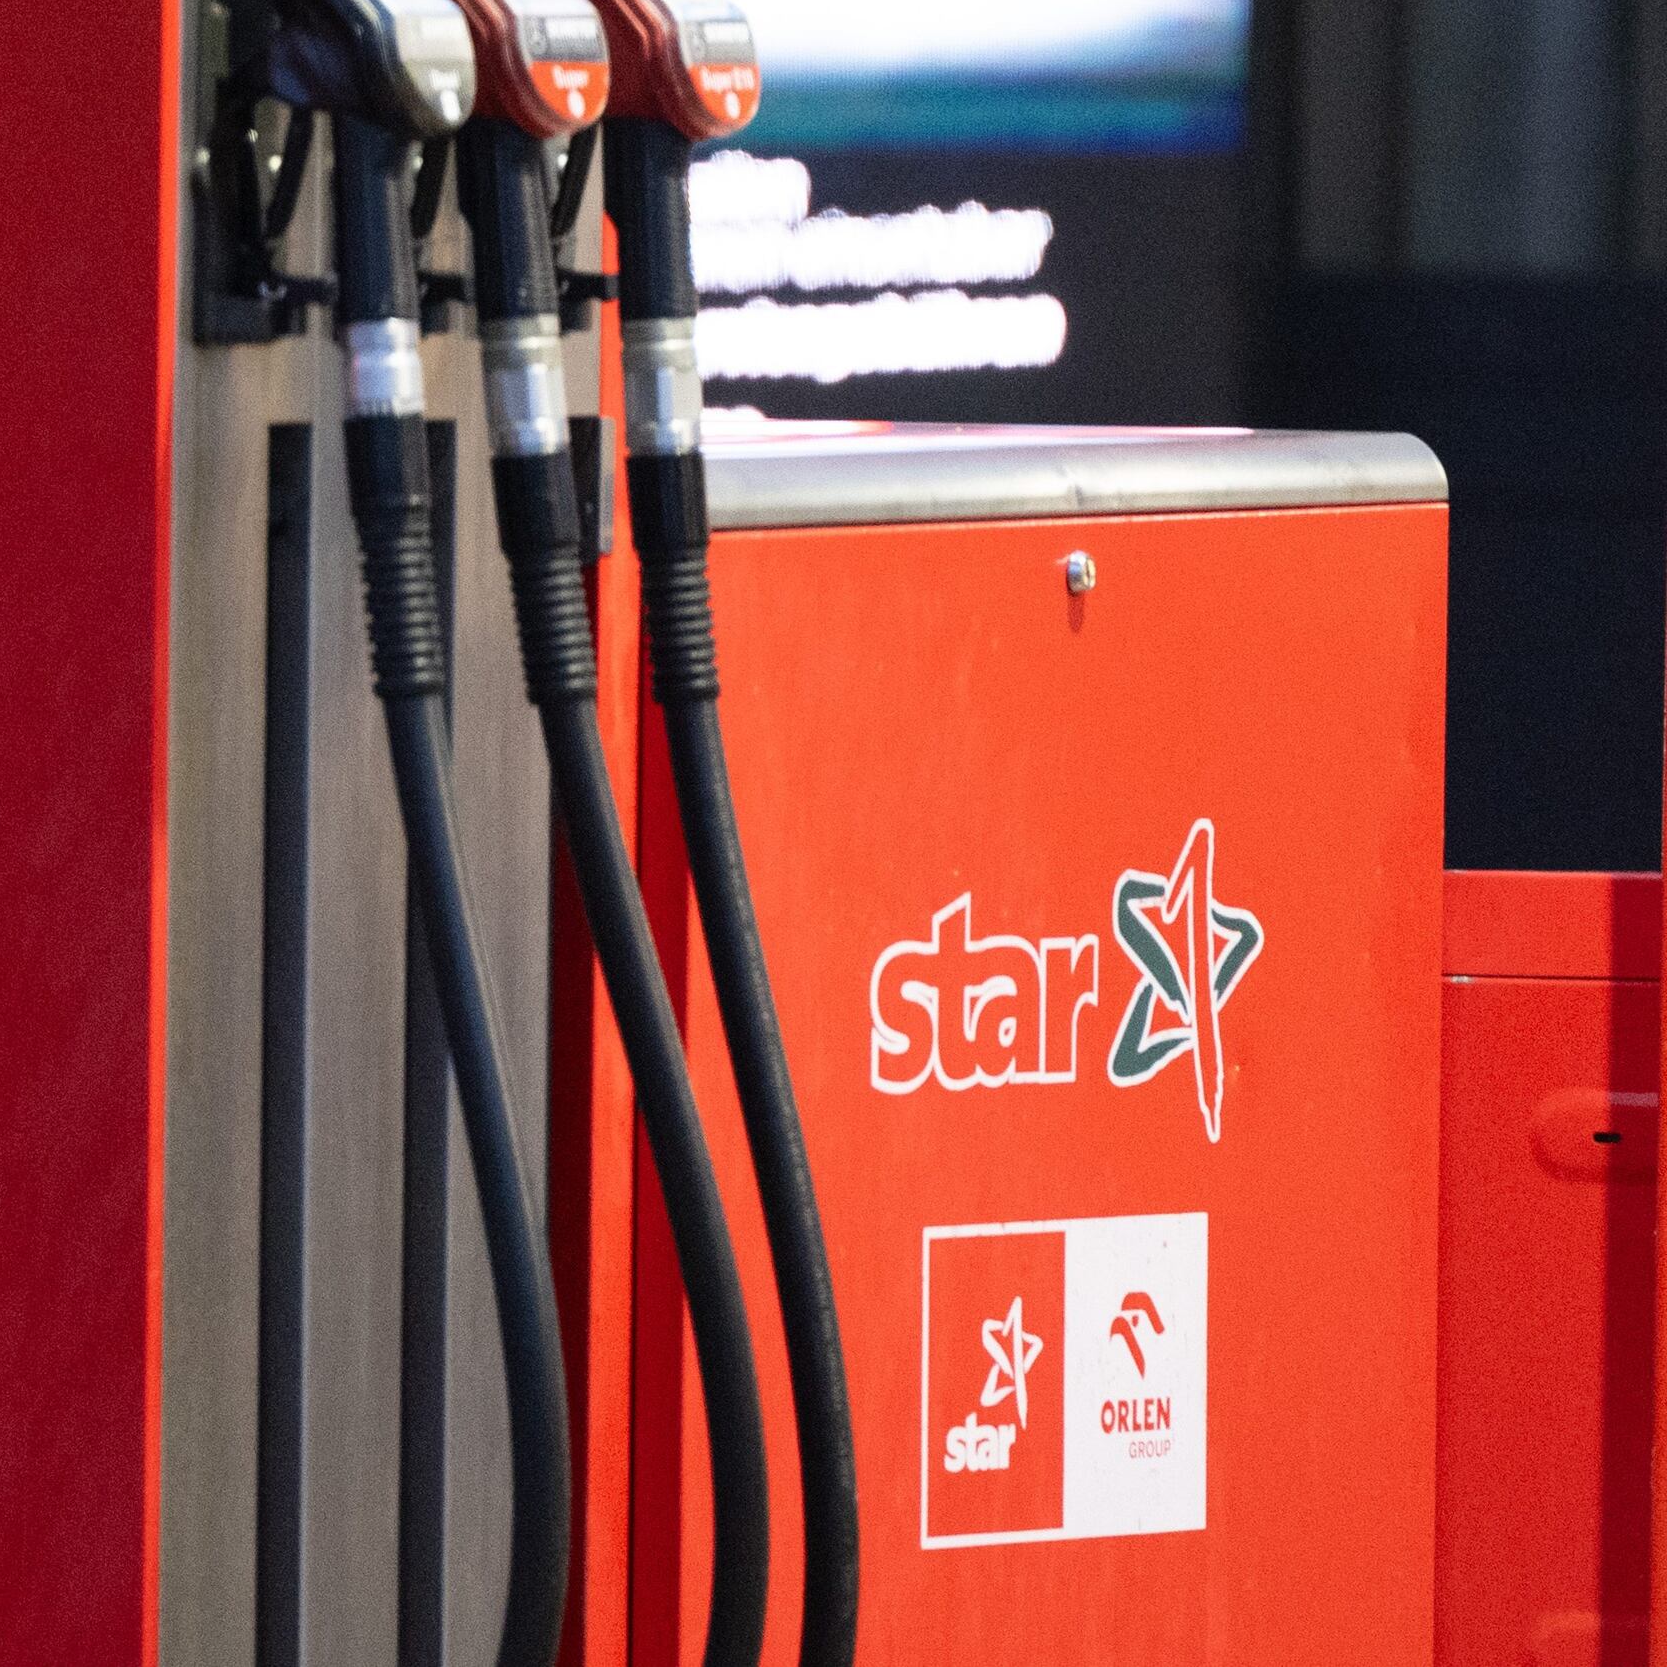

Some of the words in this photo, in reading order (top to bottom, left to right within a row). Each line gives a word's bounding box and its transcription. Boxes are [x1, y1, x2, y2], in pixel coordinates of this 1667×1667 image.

[869, 891, 1100, 1095] star
[1101, 1397, 1172, 1435] ORLEN
[943, 1411, 1017, 1474] star
[1129, 1439, 1172, 1460] GROUP
